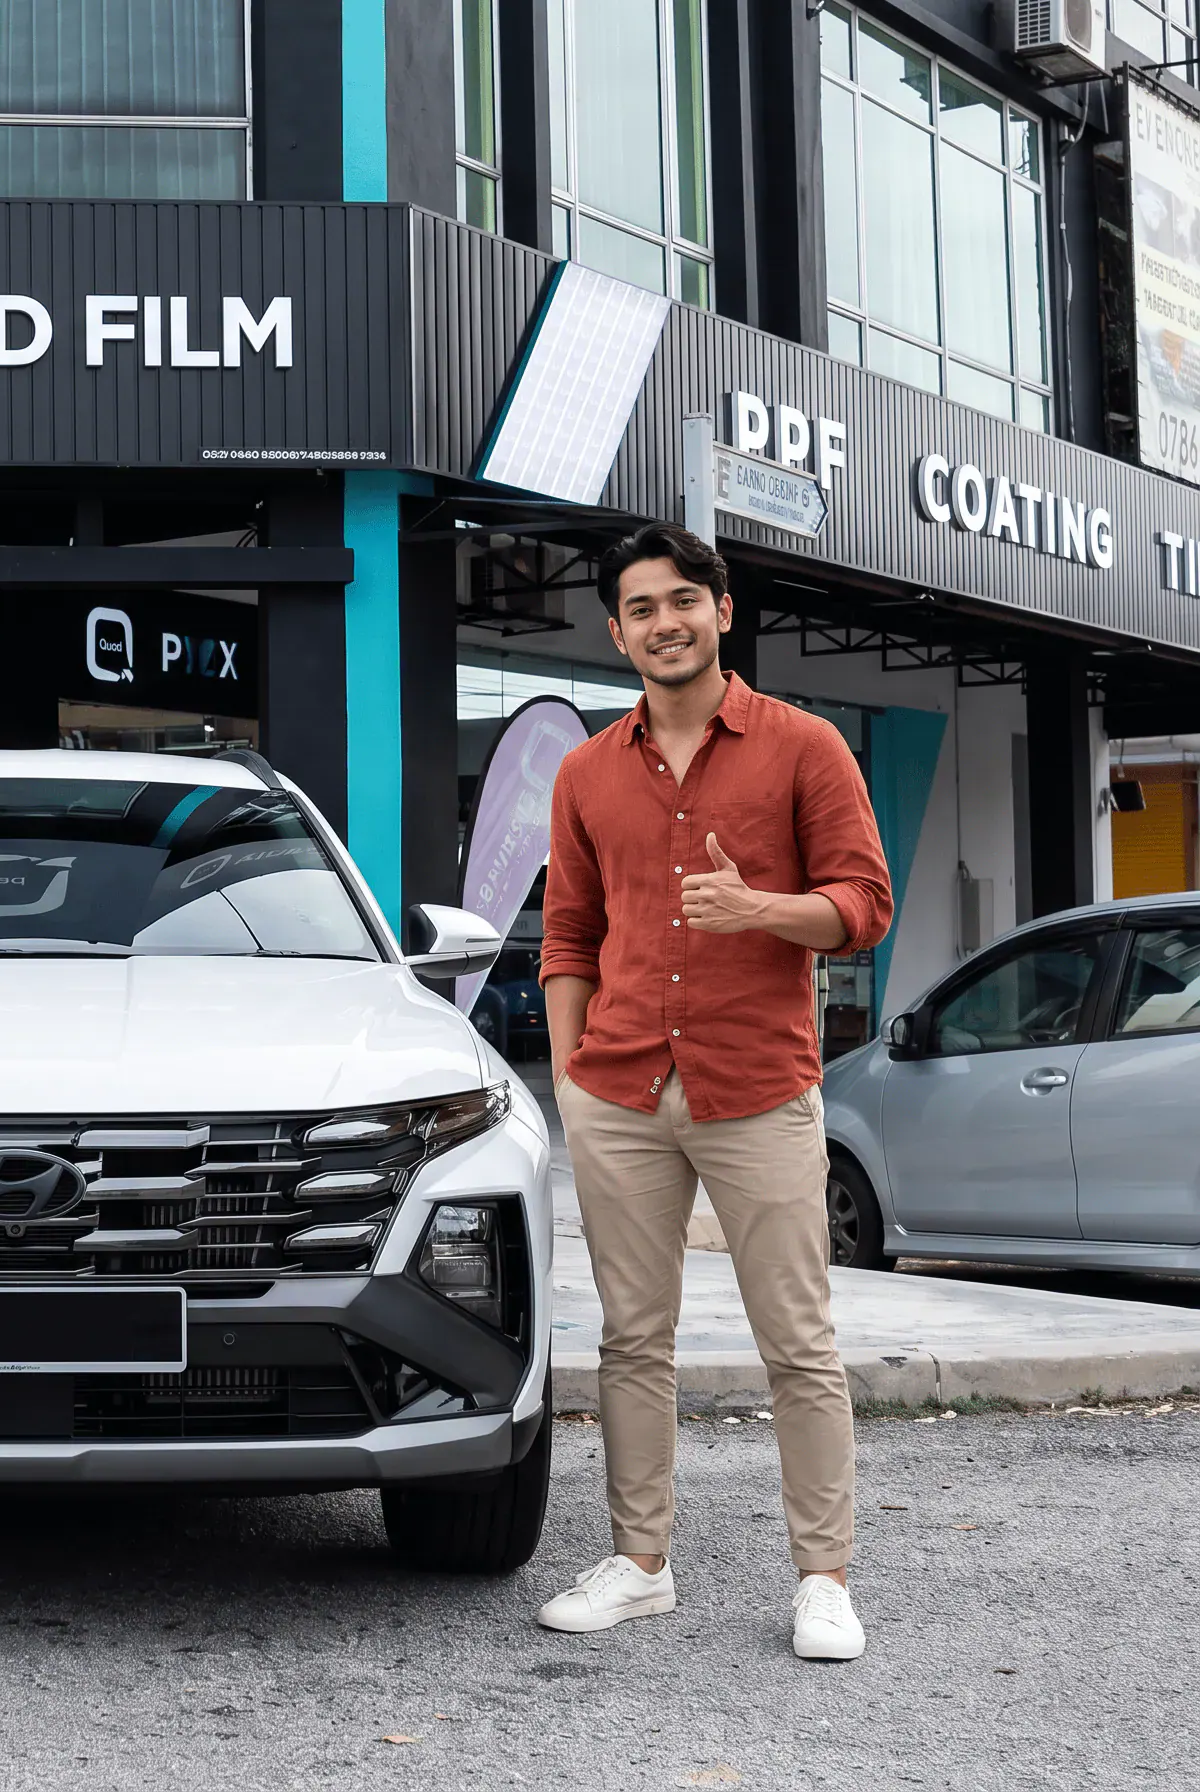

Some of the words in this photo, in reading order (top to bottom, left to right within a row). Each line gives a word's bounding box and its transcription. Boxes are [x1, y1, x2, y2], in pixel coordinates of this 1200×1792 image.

[85, 294, 294, 369] FILM
[733, 391, 846, 491] PPF
[918, 453, 1113, 569] COATING
[1161, 530, 1200, 598] TI
